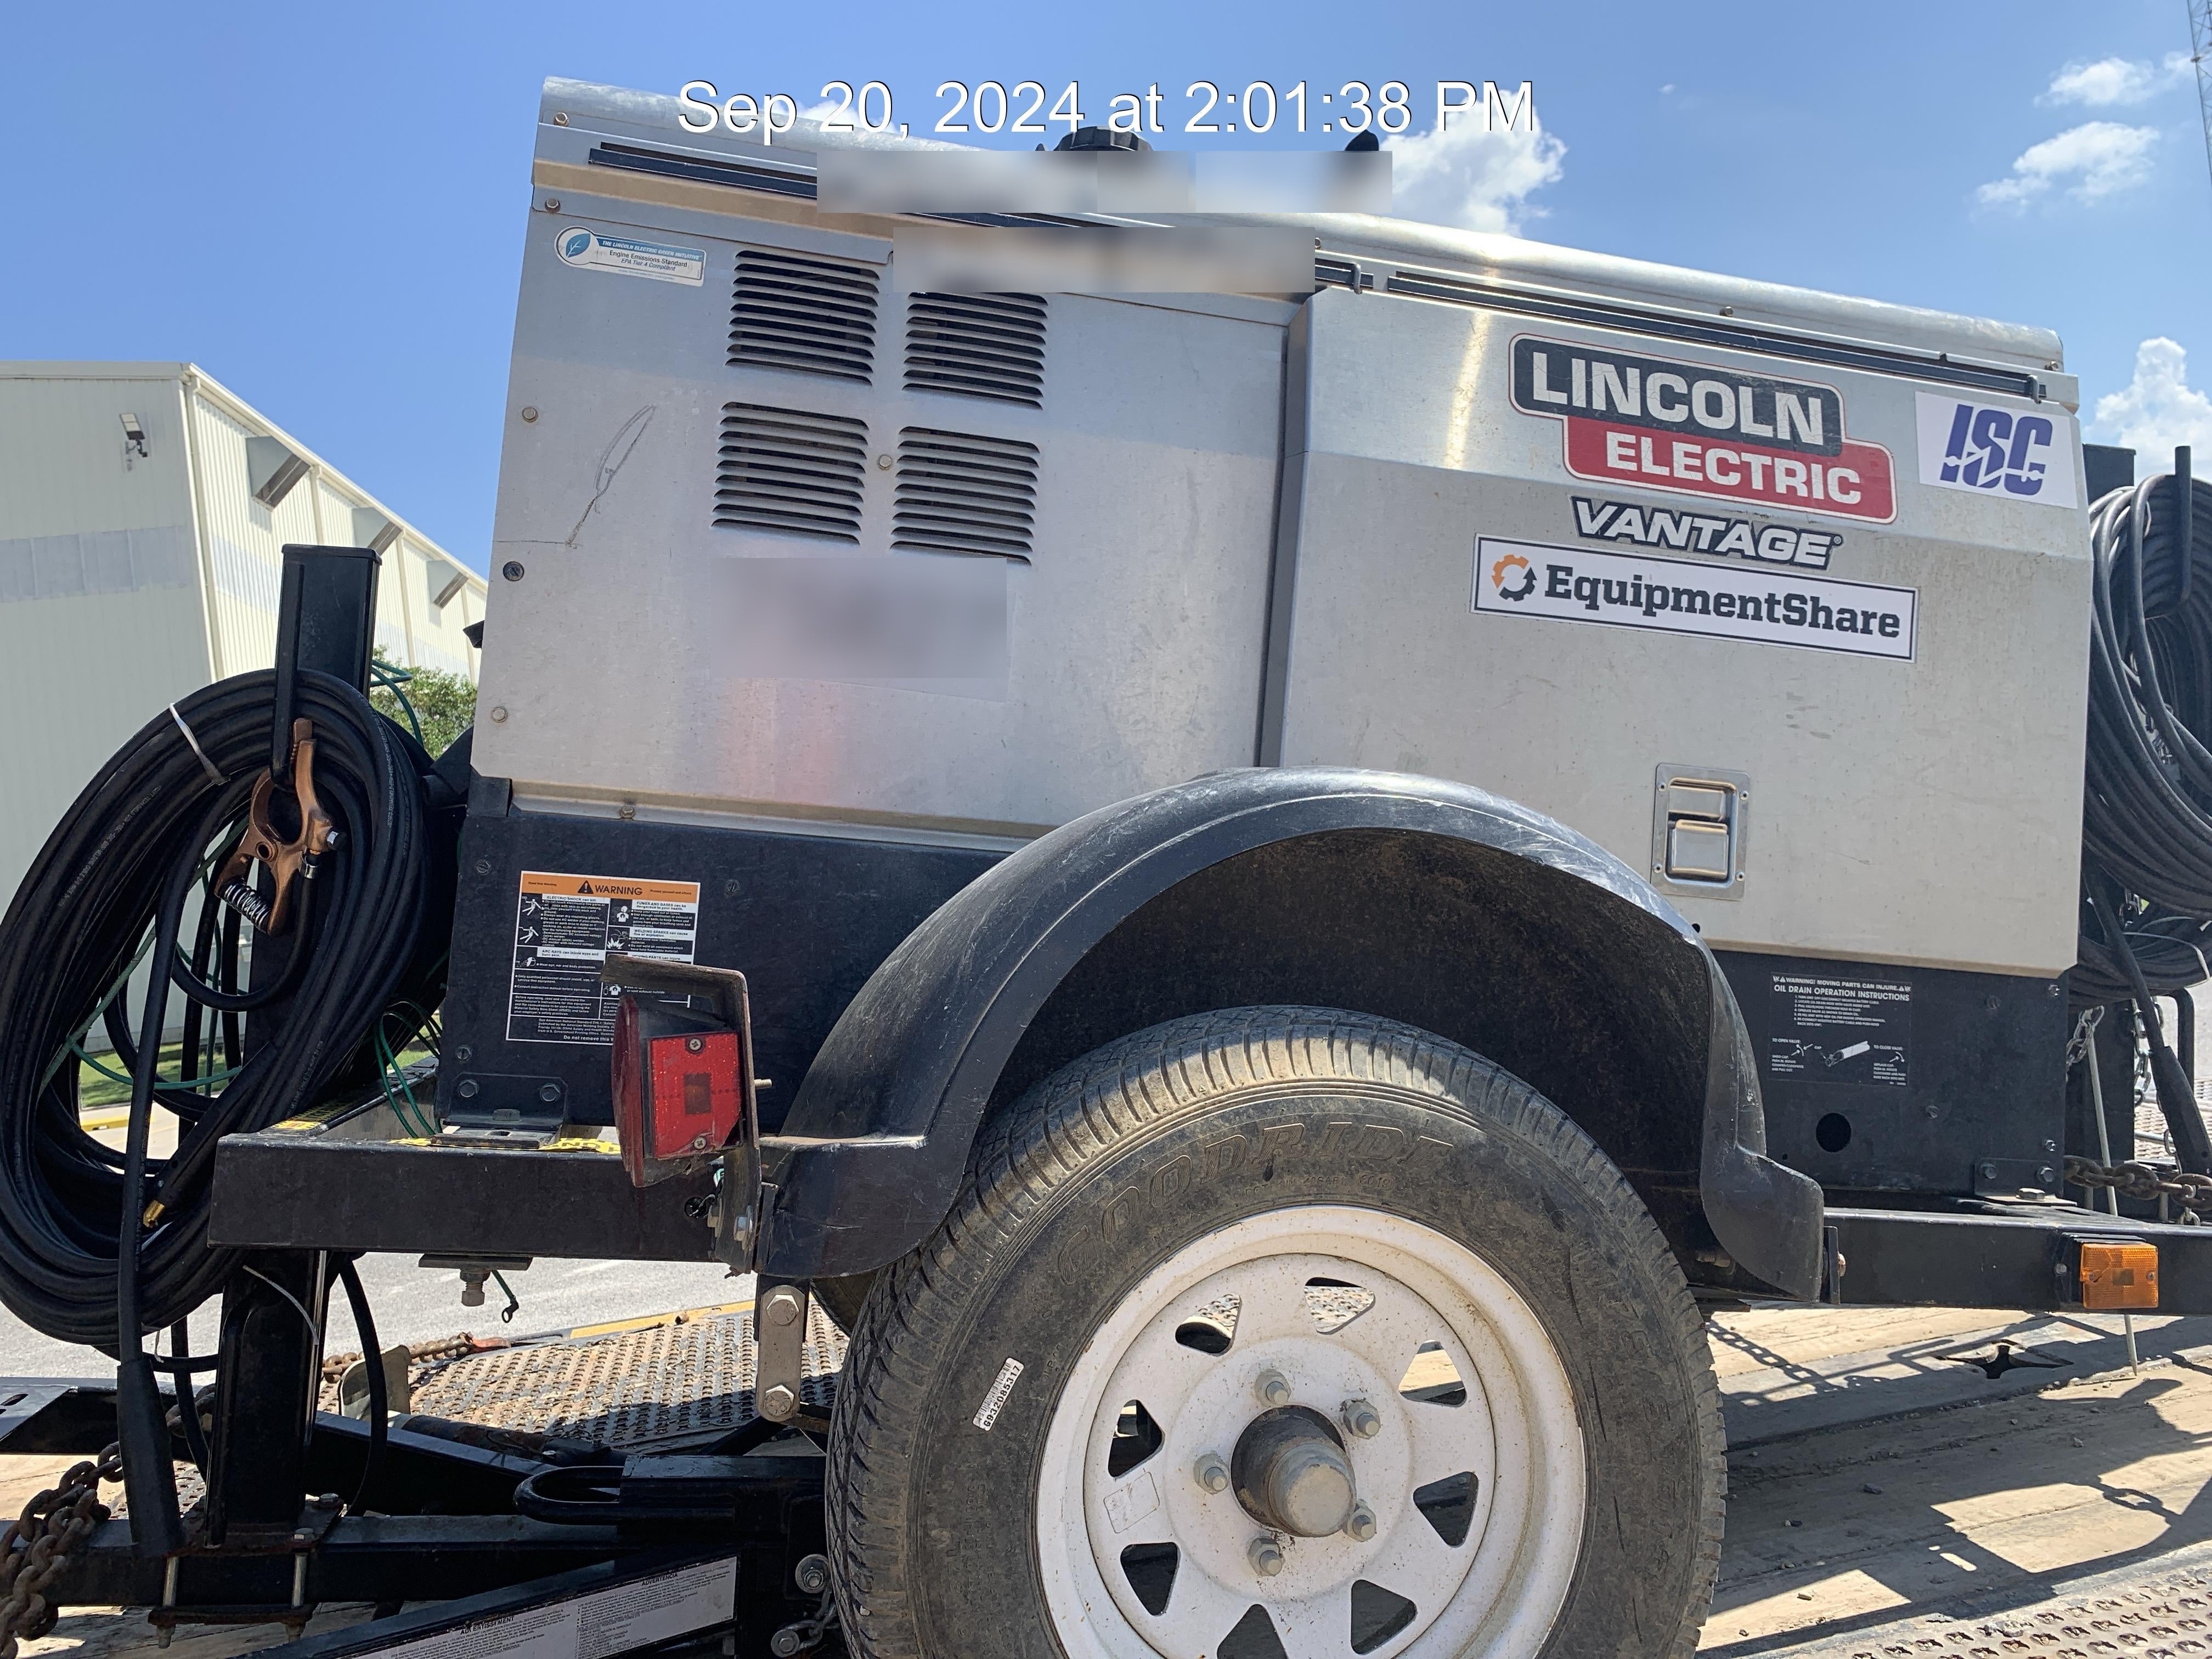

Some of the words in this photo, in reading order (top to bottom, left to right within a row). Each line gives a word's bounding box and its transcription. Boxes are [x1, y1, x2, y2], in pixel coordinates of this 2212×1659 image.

[631, 253, 659, 262] Emissions
[662, 258, 687, 267] Standard
[648, 263, 675, 271] Compliant
[1532, 352, 1822, 445] LINCOLN
[1607, 432, 1863, 505] ELECTRIC
[1940, 404, 2052, 496] ISC
[1545, 563, 1901, 638] EquipmentShare
[595, 884, 642, 896] WARNING
[1788, 985, 1811, 994] DRAIN
[1814, 988, 1855, 997] OPERATION
[1858, 990, 1909, 1001] INSTRUCTIONS
[984, 1365, 1020, 1427] G932085317
